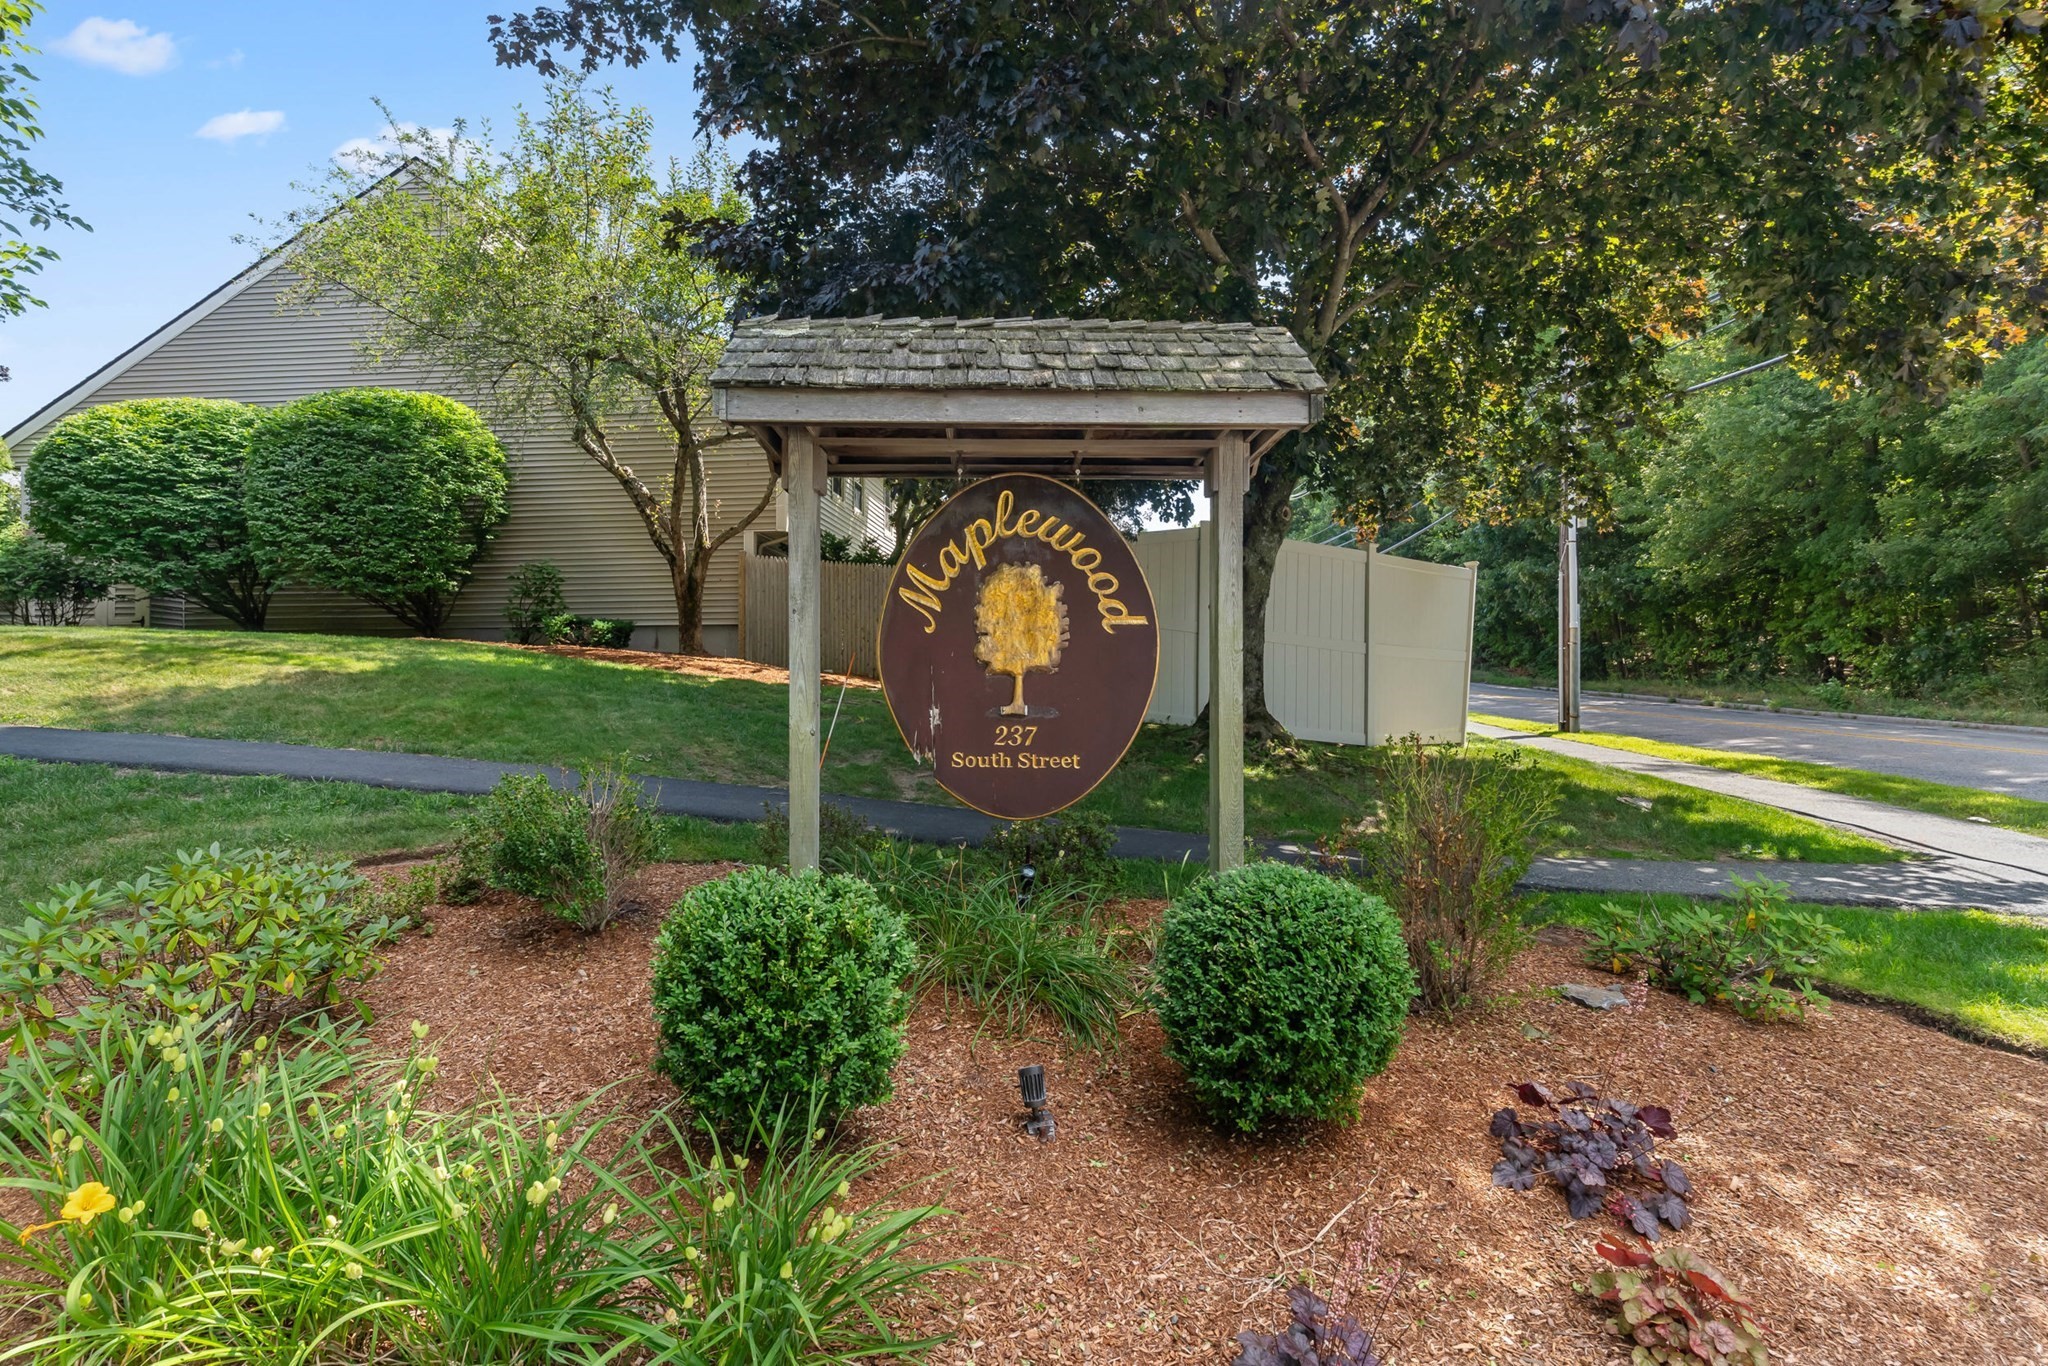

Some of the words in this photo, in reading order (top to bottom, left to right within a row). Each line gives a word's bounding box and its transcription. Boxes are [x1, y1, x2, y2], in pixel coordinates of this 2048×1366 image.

[898, 489, 1149, 635] Maplewood
[993, 725, 1038, 747] 237
[951, 752, 1013, 769] South
[1017, 752, 1081, 769] Street
